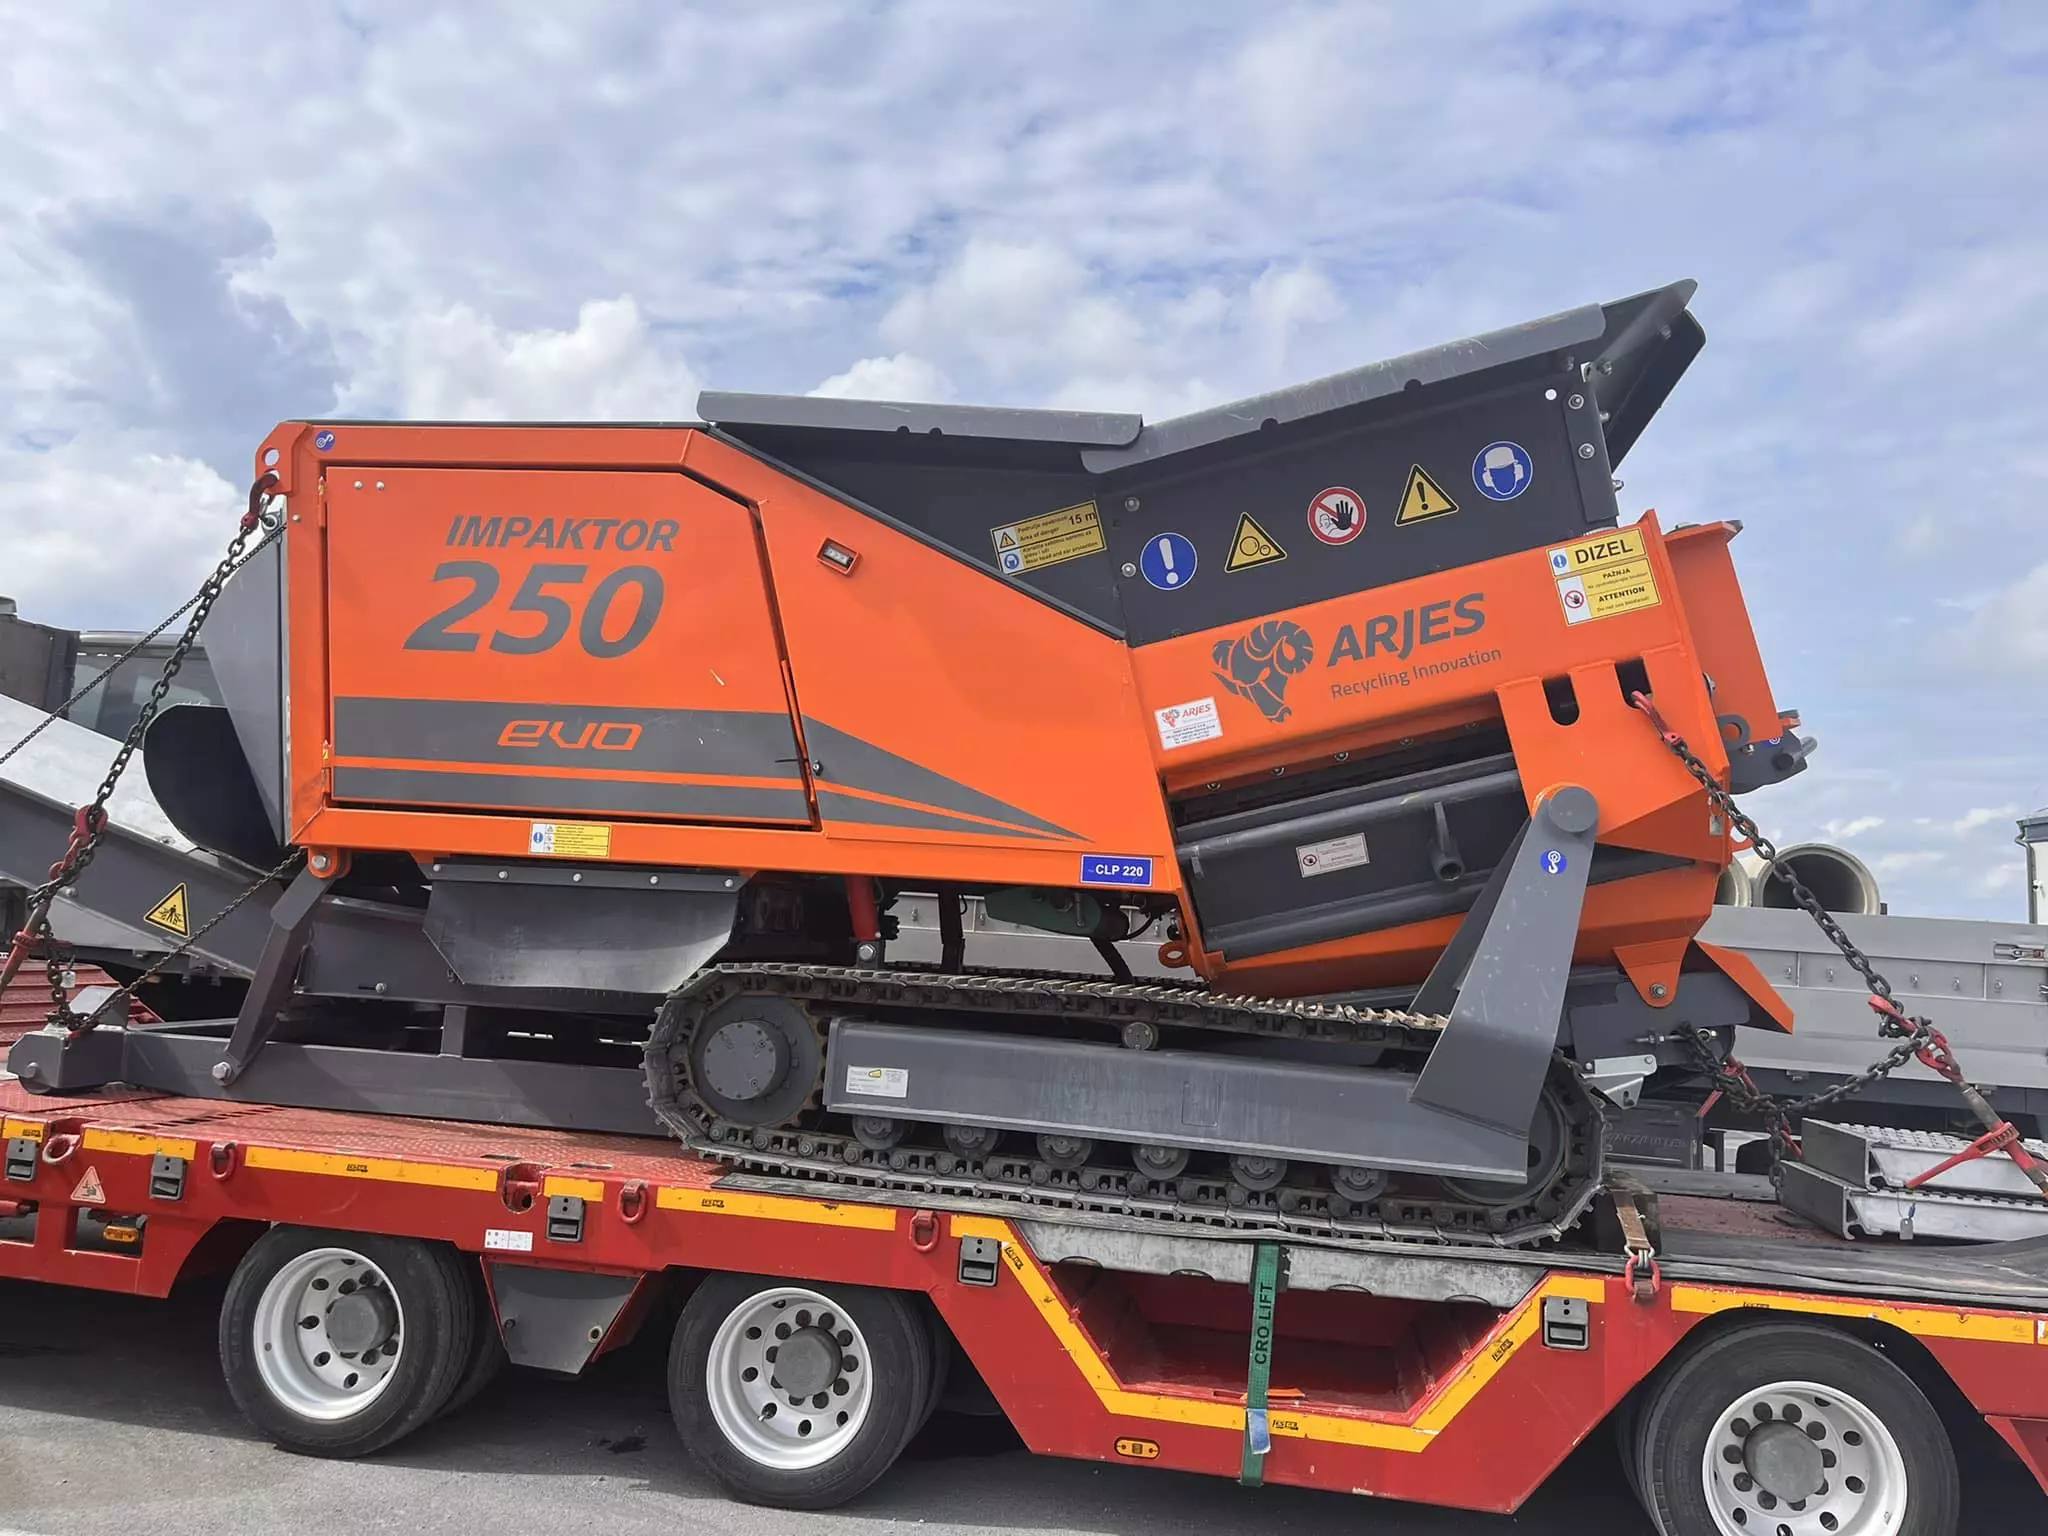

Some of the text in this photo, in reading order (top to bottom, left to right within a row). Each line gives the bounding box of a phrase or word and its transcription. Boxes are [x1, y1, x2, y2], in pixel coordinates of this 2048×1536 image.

[1069, 514, 1082, 526] 15
[1085, 512, 1097, 522] m
[445, 515, 680, 551] IMPAKTOR
[1575, 540, 1633, 564] DIZEL
[1603, 568, 1630, 579] PAŽNJA
[1599, 586, 1645, 602] ATTENTION
[402, 560, 665, 659] 250
[1327, 592, 1486, 668] ARJES
[1330, 648, 1502, 699] Recycling Innovation
[1182, 704, 1210, 718] ARJES
[1096, 864, 1144, 876] CLP 220
[1254, 1282, 1272, 1365] CRO LIFT
